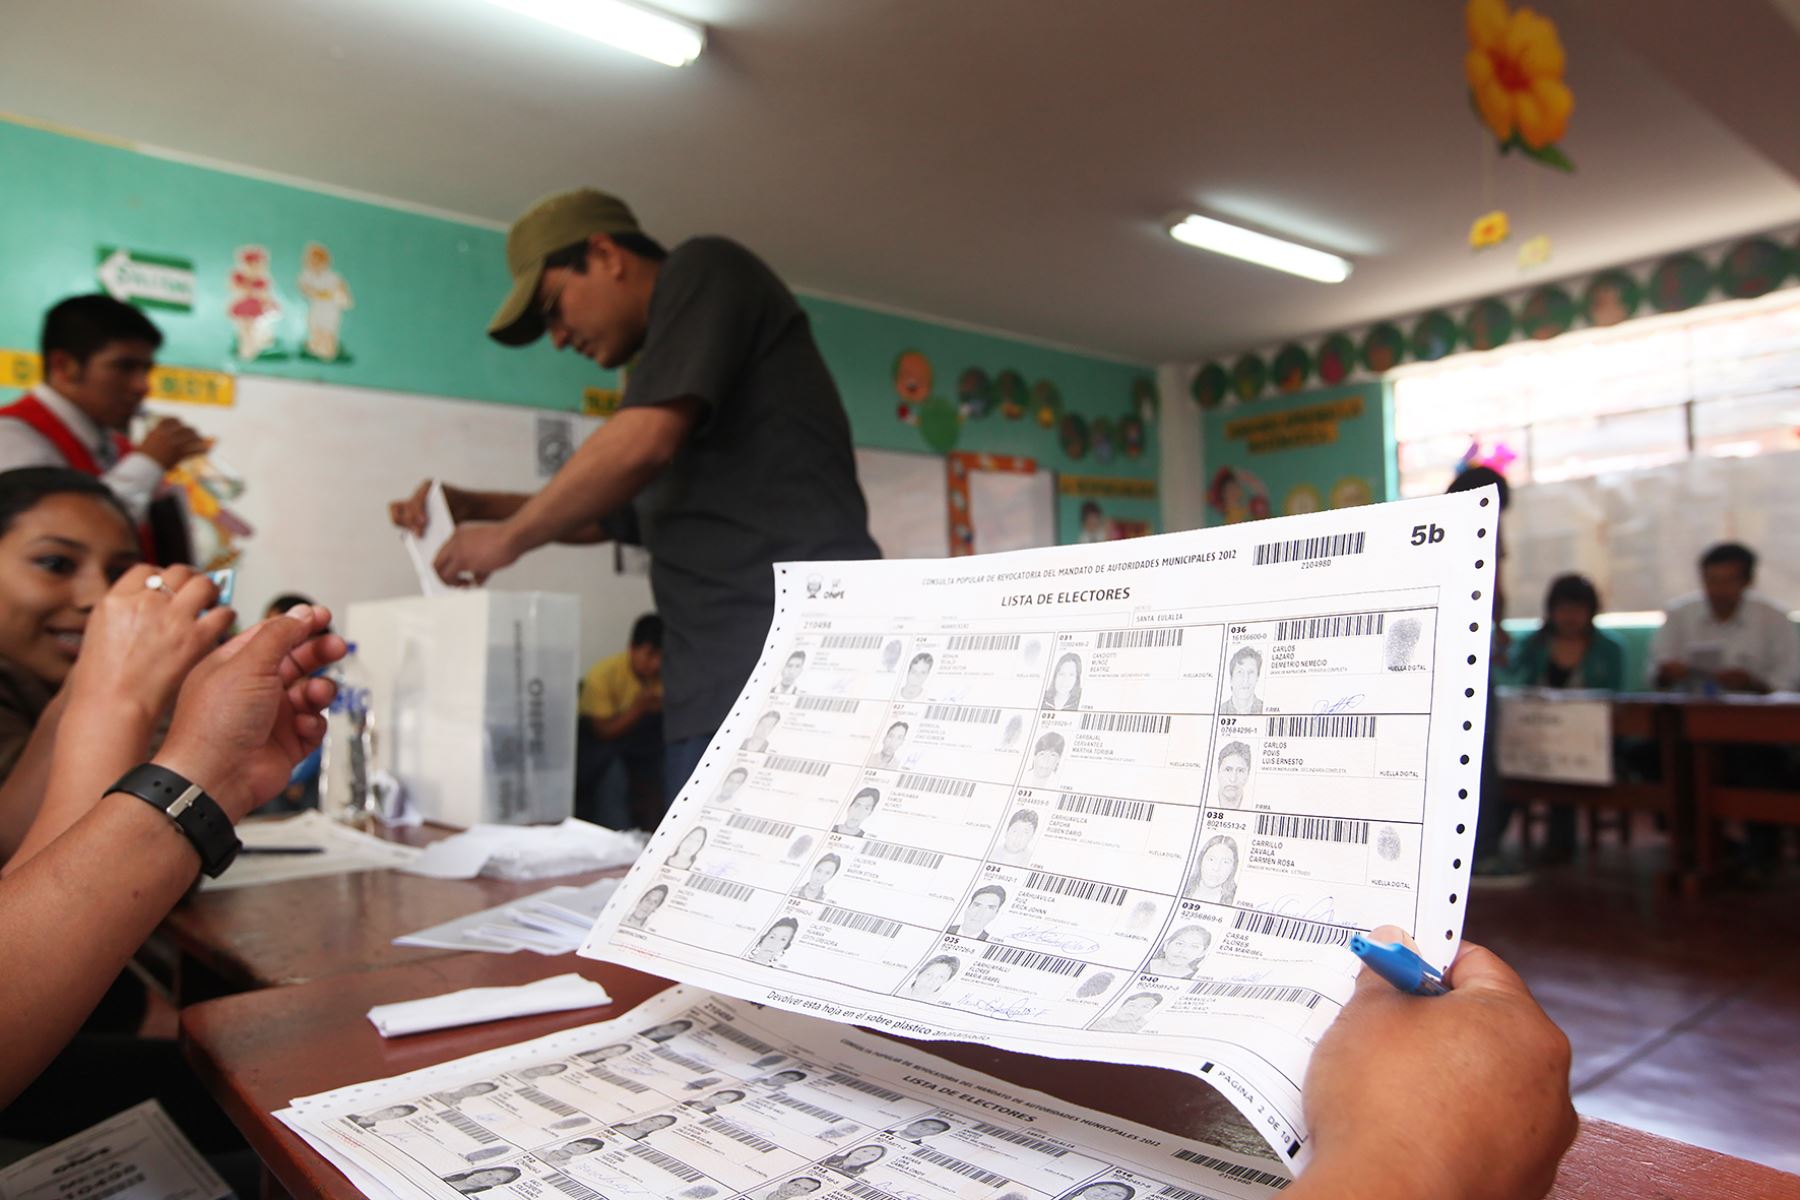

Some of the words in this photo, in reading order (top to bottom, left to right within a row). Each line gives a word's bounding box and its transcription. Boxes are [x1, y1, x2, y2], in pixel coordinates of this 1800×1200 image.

[1410, 523, 1445, 546] 5b
[956, 575, 984, 584] POPULAR
[986, 574, 996, 582] DE
[997, 570, 1041, 582] REVOCATORIA
[1043, 569, 1056, 578] DEL
[1058, 565, 1093, 576] MANDATO
[1095, 564, 1105, 573] DE
[1107, 559, 1160, 572] AUTORIDADES
[1162, 552, 1216, 566] MUNICIPALES
[1218, 549, 1237, 560] 2012
[1002, 594, 1033, 606] LISTA
[1036, 592, 1054, 605] DE
[1057, 586, 1130, 604] ELECTORES
[1136, 614, 1154, 622] SANTA
[1158, 613, 1183, 622] EULALIA
[1271, 660, 1299, 669] DEMETRIO
[1300, 660, 1328, 668] NEMECIO
[1278, 758, 1304, 766] ERNESTO
[1207, 811, 1224, 820] 038
[1206, 820, 1246, 830] 80216513-2
[1252, 840, 1283, 850] CARRILLO
[1250, 848, 1275, 856] ZAVALA
[1250, 856, 1276, 866] CARMEN
[1277, 858, 1295, 867] ROSA
[1011, 903, 1029, 911] ERICK
[1182, 902, 1201, 911] 039
[944, 936, 960, 944] 035
[1225, 932, 1250, 940] CASAS
[1222, 938, 1250, 948] FLORES
[1234, 946, 1264, 957] MARIBEL
[1140, 974, 1159, 983] 040
[766, 990, 803, 1007] Devolver
[803, 1000, 822, 1010] esta
[822, 1004, 842, 1016] hoja
[842, 1010, 855, 1018] en
[855, 1011, 866, 1020] el
[866, 1014, 892, 1026] sobre
[902, 1074, 936, 1090] LISTA
[940, 1087, 958, 1097] DE
[959, 1092, 1036, 1122] ELECTORES
[913, 1064, 958, 1084] REVOCATORIA
[959, 1080, 972, 1088] DEL
[976, 1084, 1012, 1100] MANDATO
[1012, 1096, 1023, 1105] DE
[1024, 1100, 1080, 1122] AUTORIDADES
[1080, 1118, 1138, 1142] MUNICIPALES
[1139, 1136, 1162, 1148] 2012
[1218, 1070, 1254, 1103] PAGINA
[1258, 1105, 1264, 1114] 2
[1267, 1116, 1280, 1131] DE
[1280, 1130, 1290, 1144] 10
[1026, 1131, 1046, 1140] SANTA
[1047, 1137, 1076, 1148] EULALIA
